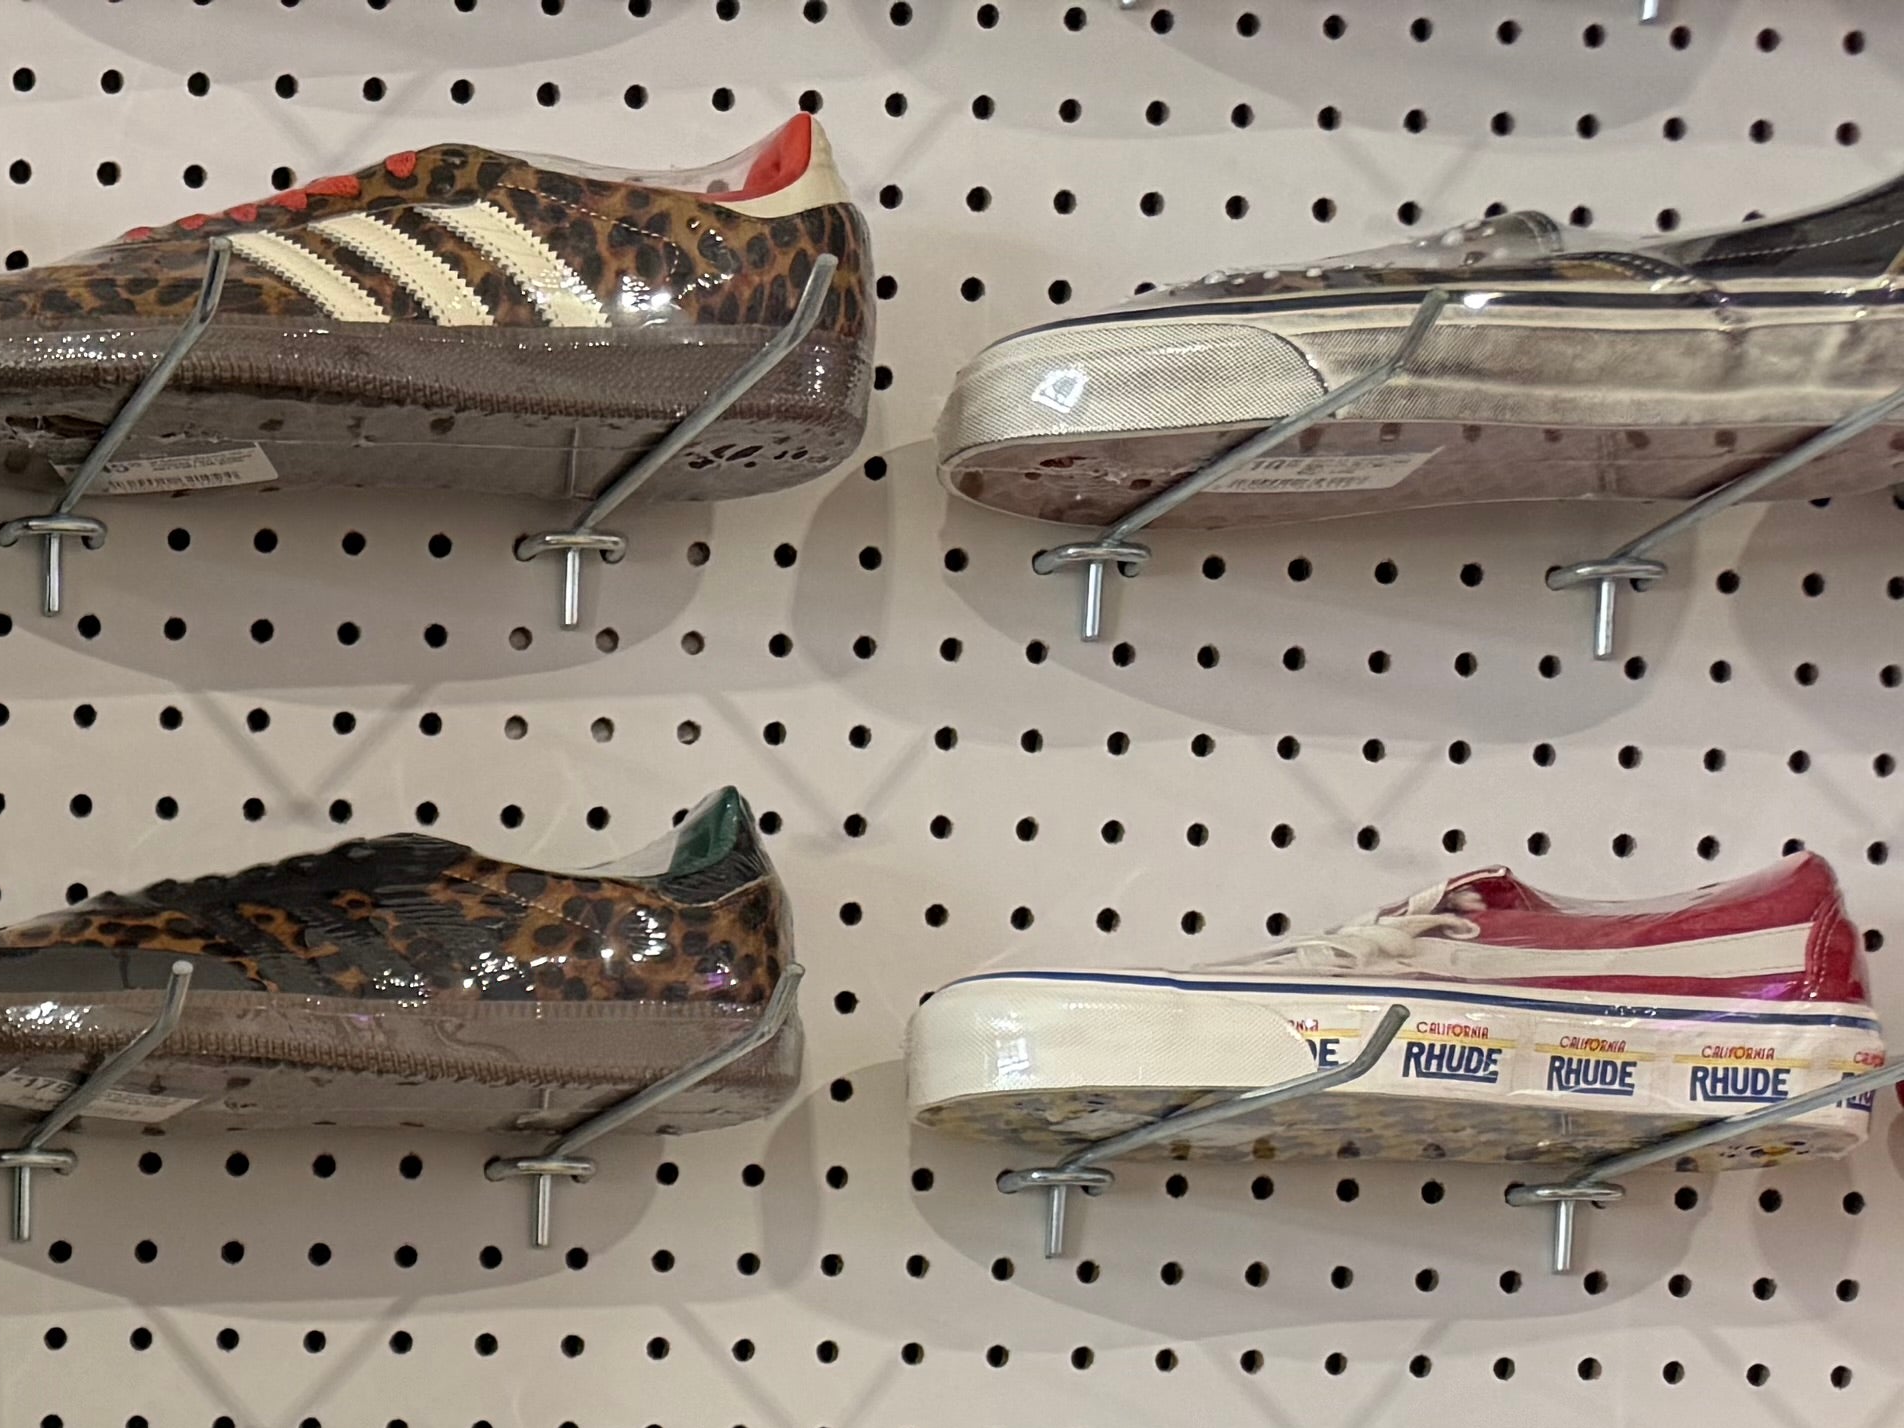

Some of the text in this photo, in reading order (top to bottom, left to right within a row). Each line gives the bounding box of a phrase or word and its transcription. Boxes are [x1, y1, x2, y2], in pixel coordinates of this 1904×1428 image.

[1417, 1021, 1489, 1039] CALIFORNIA
[1561, 1036, 1626, 1053] CALIFORNIA
[1701, 1045, 1775, 1061] CALIFORNIA
[1403, 1041, 1502, 1083] RHUDE
[1547, 1055, 1637, 1096] RHUDE
[1690, 1066, 1791, 1102] RHUDE
